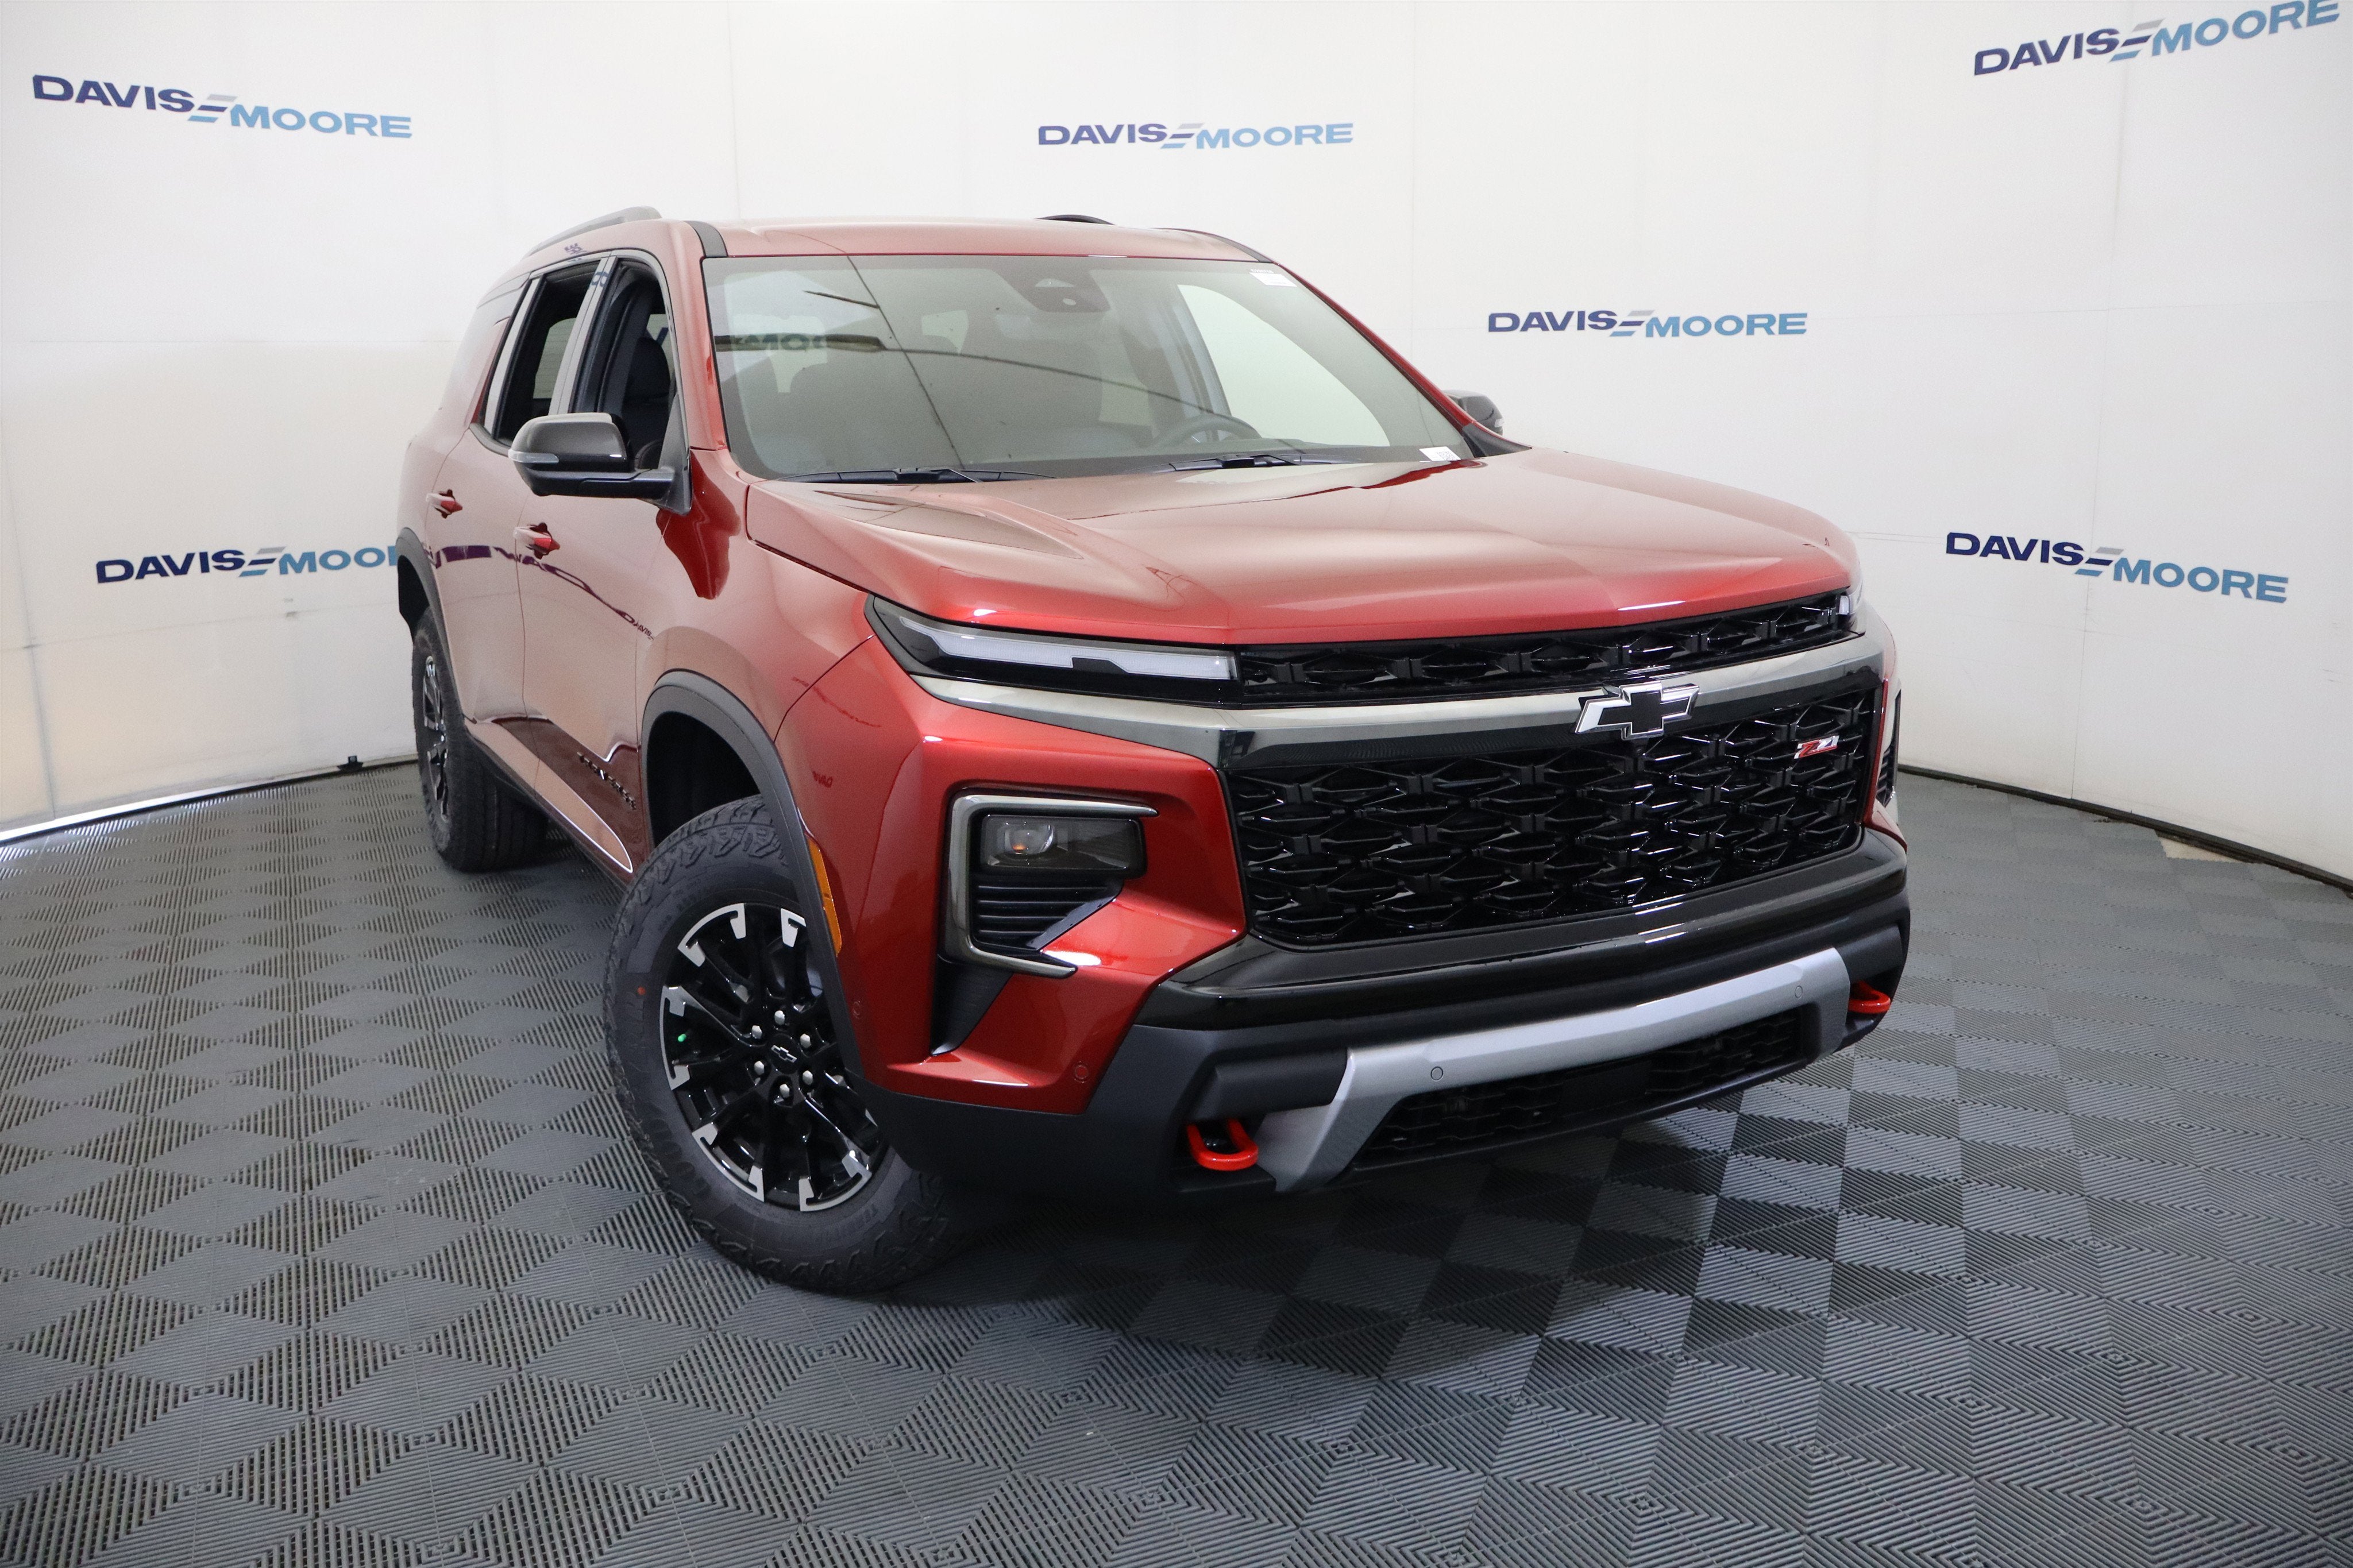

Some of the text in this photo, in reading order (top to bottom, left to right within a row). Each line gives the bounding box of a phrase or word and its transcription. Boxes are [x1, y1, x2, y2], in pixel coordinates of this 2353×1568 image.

[1973, 0, 2340, 76] DAVIS MOORE
[32, 74, 412, 139] DAVIS MOORE
[1038, 122, 1353, 150] DAVIS MOORE
[1488, 310, 1808, 338] DAVIS MOORE
[95, 549, 245, 584] DAVIS
[279, 544, 398, 576] MOO
[1946, 531, 2289, 604] DAVIS MOORE
[1794, 735, 1840, 759] Z71
